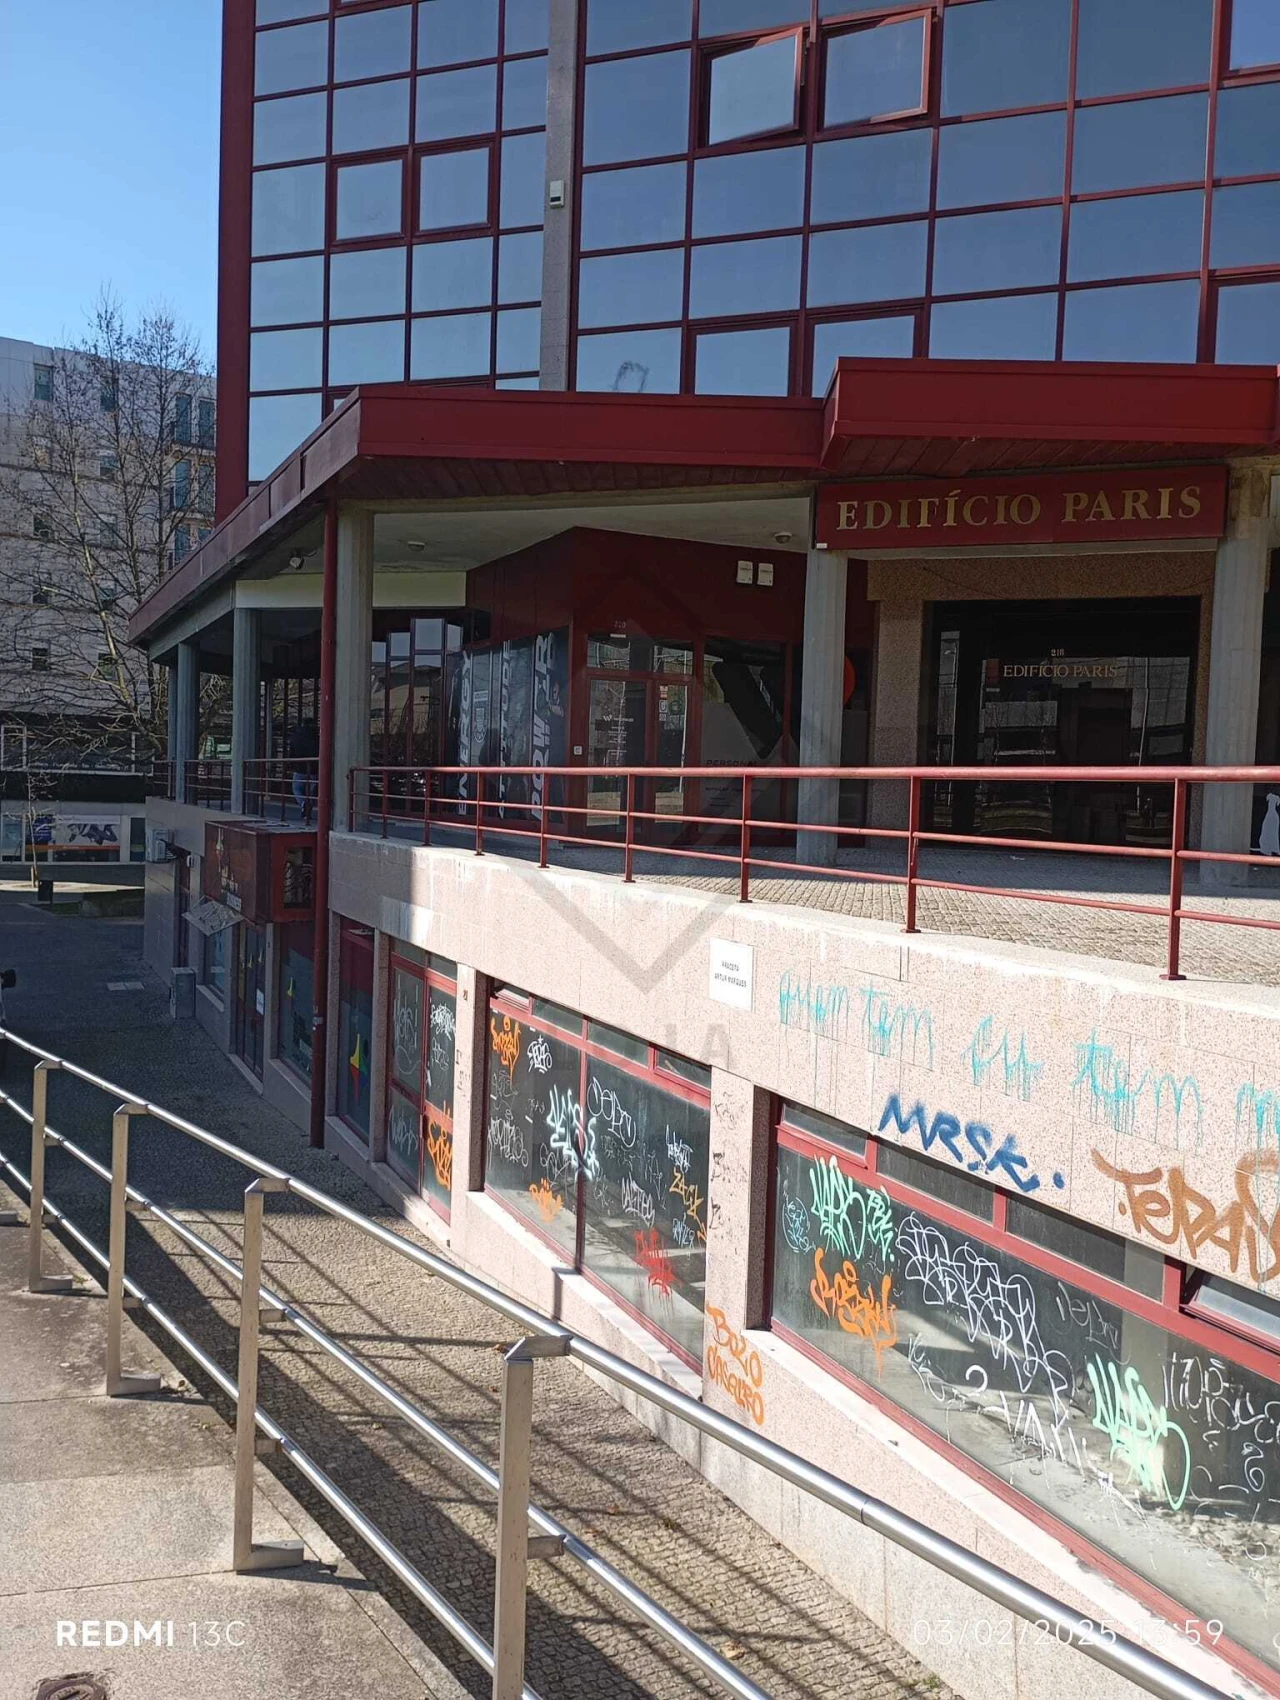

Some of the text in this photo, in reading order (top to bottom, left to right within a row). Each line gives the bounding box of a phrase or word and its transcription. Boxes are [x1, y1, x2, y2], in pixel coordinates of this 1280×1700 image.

[836, 486, 1202, 531] EDIFÍCIO PARIS
[1073, 664, 1118, 678] PARIS
